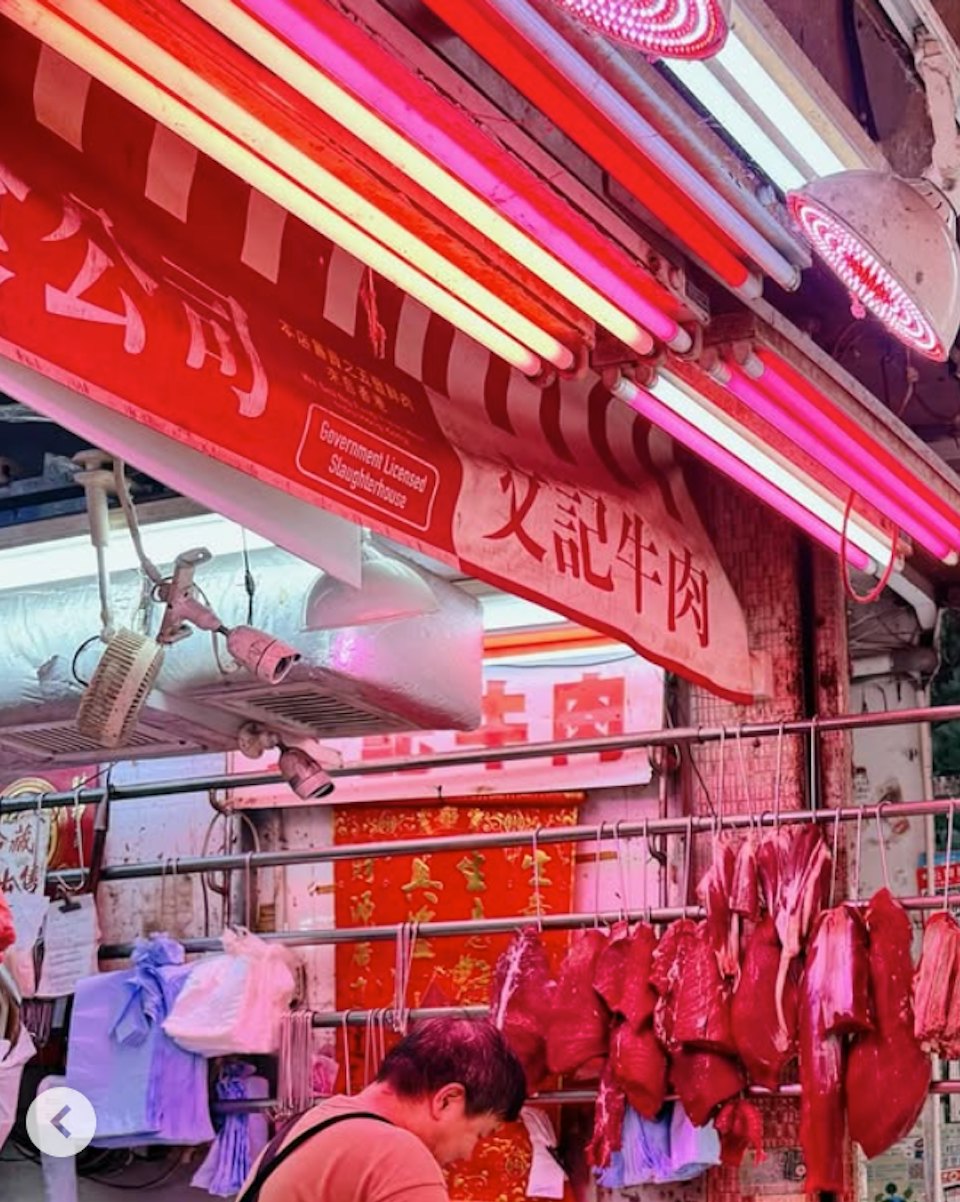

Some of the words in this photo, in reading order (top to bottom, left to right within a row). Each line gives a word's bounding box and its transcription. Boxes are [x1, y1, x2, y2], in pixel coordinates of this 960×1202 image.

[0, 165, 269, 418] 公司
[319, 420, 383, 469] Government
[384, 454, 428, 493] Licensed
[328, 453, 407, 509] Slaughterhouse
